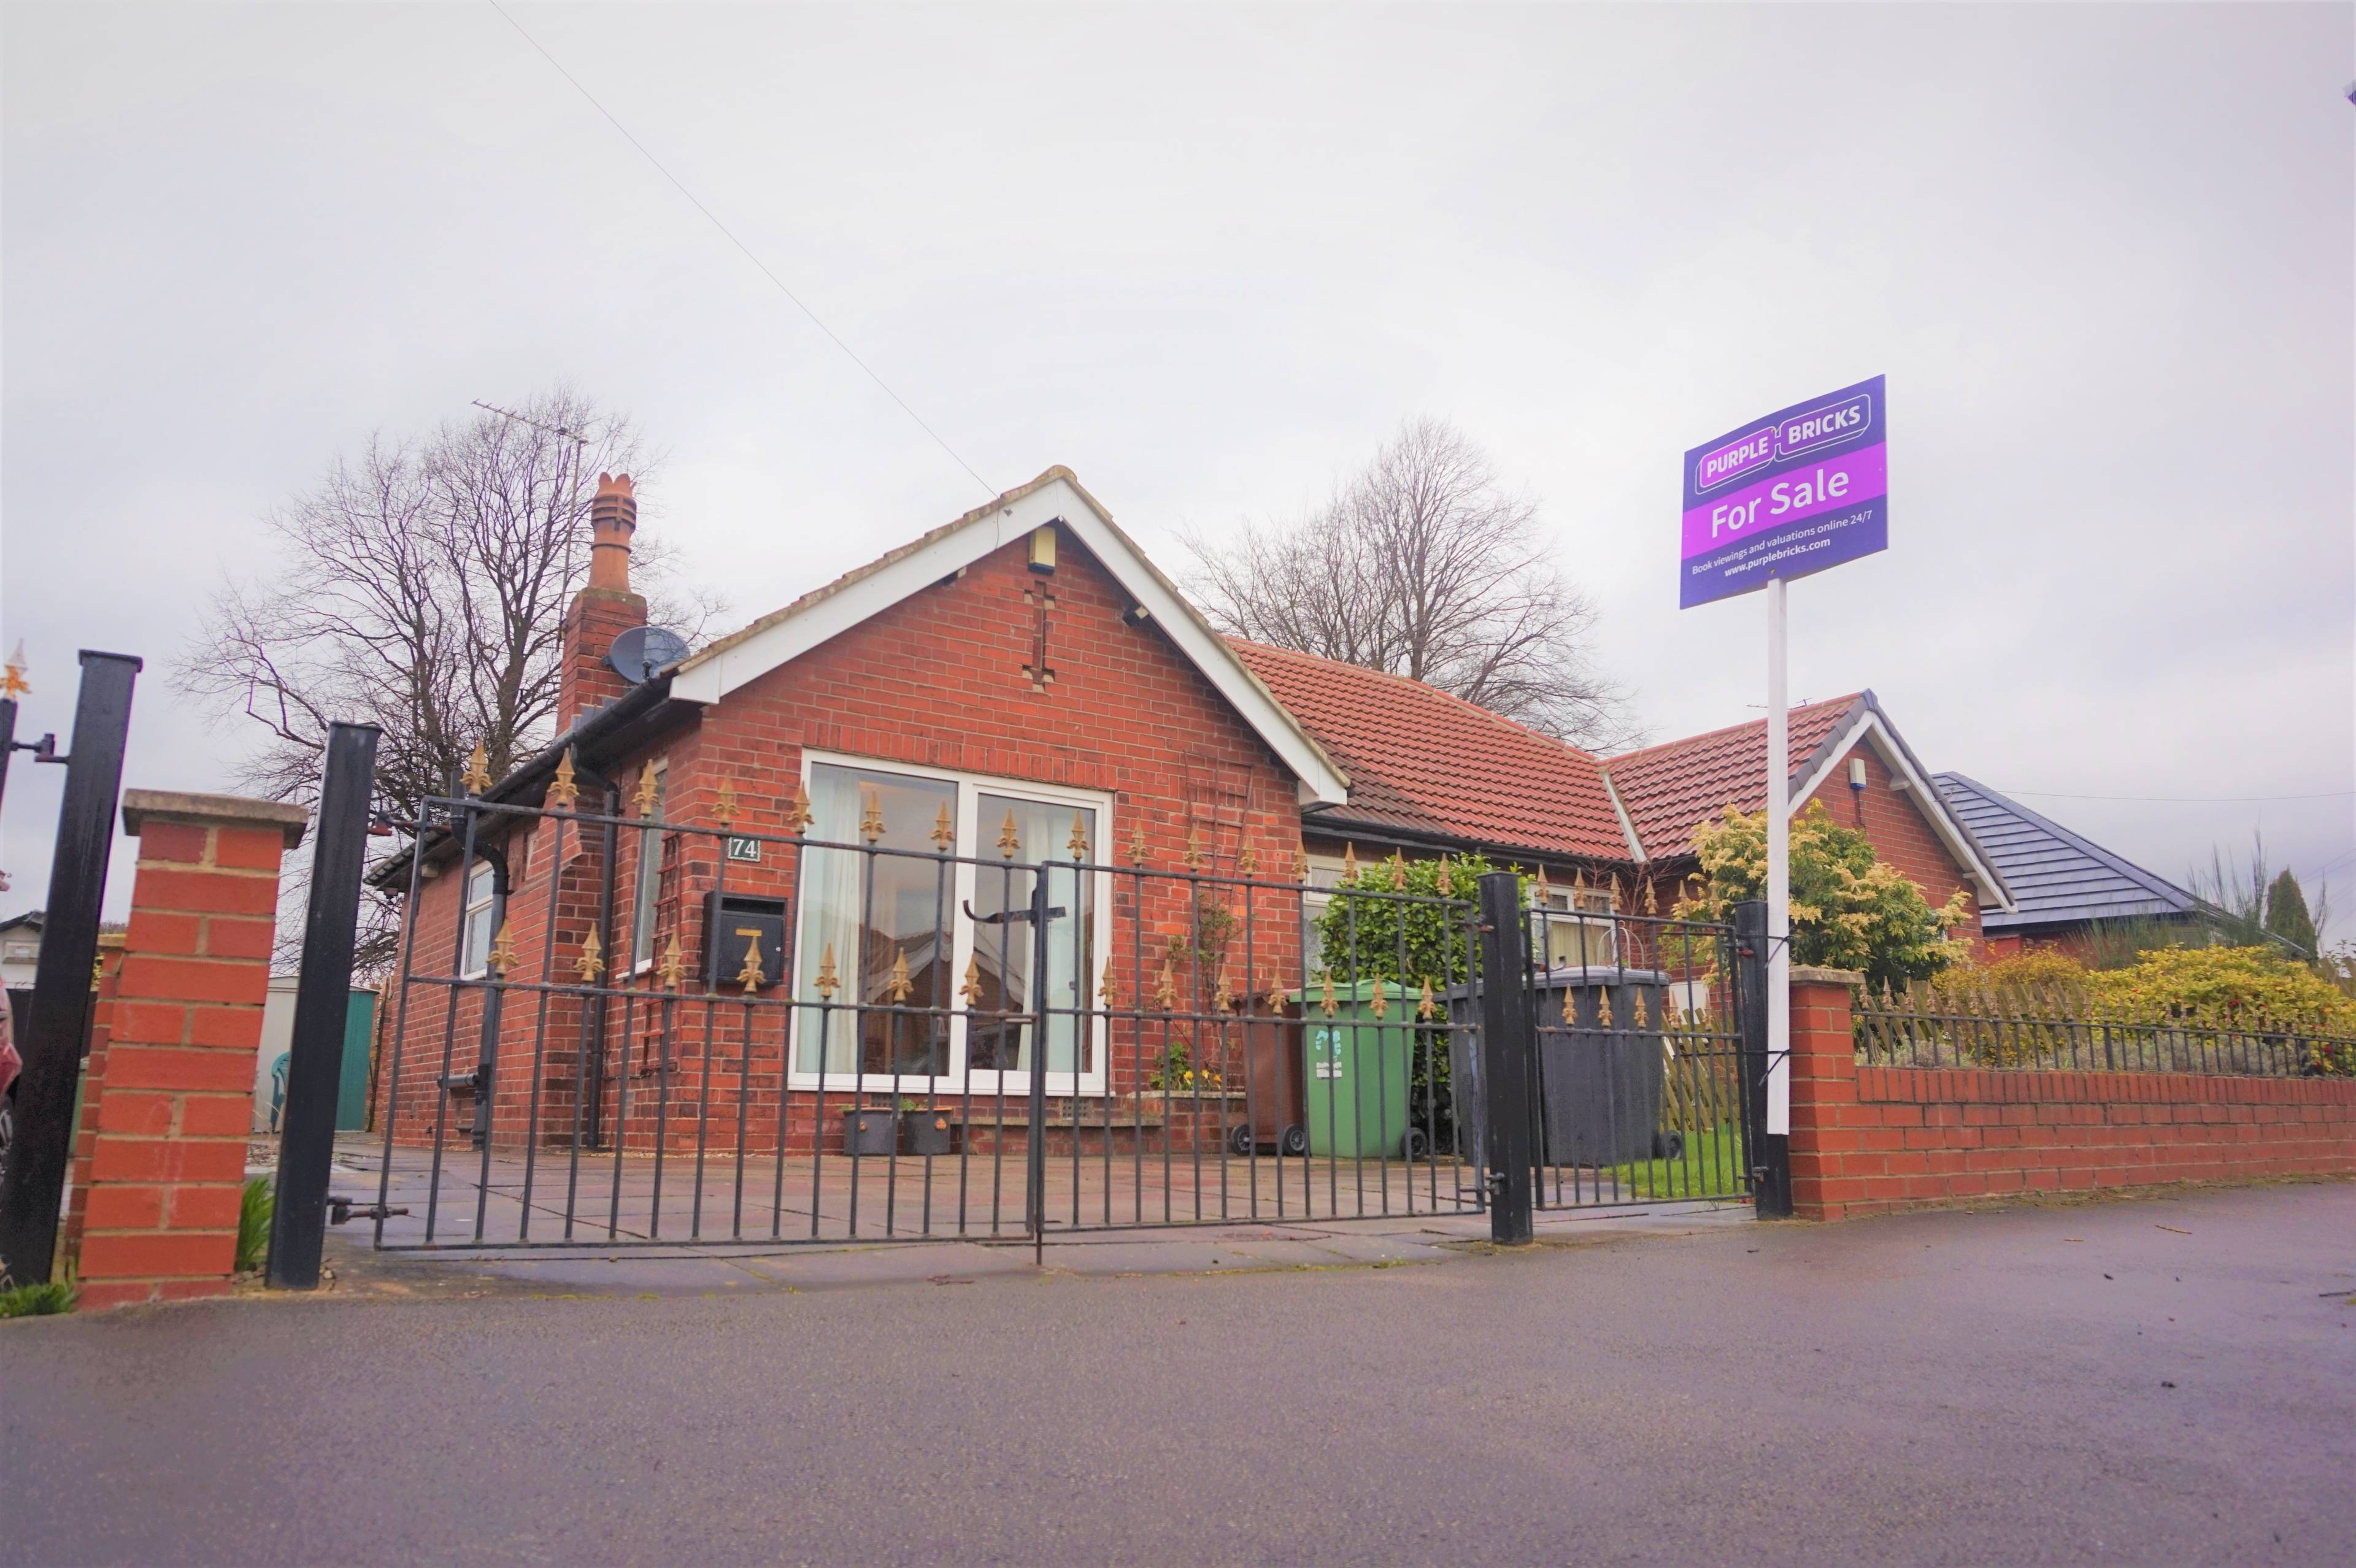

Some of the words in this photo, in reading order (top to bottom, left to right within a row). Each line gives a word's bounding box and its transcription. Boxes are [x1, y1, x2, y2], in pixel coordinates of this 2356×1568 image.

[1707, 436, 1768, 478] PURPLE
[1788, 405, 1861, 445] BRICKS
[1712, 497, 1761, 539] For
[1770, 469, 1849, 515] Sale
[1692, 561, 1712, 575] Book
[1714, 547, 1748, 568] viewings
[1749, 540, 1766, 554] and
[1767, 528, 1815, 547] valuations
[1817, 518, 1849, 533] online
[1850, 510, 1873, 526] 24/7
[1725, 538, 1831, 577] www.purplebricks.com
[733, 839, 756, 857] 74
